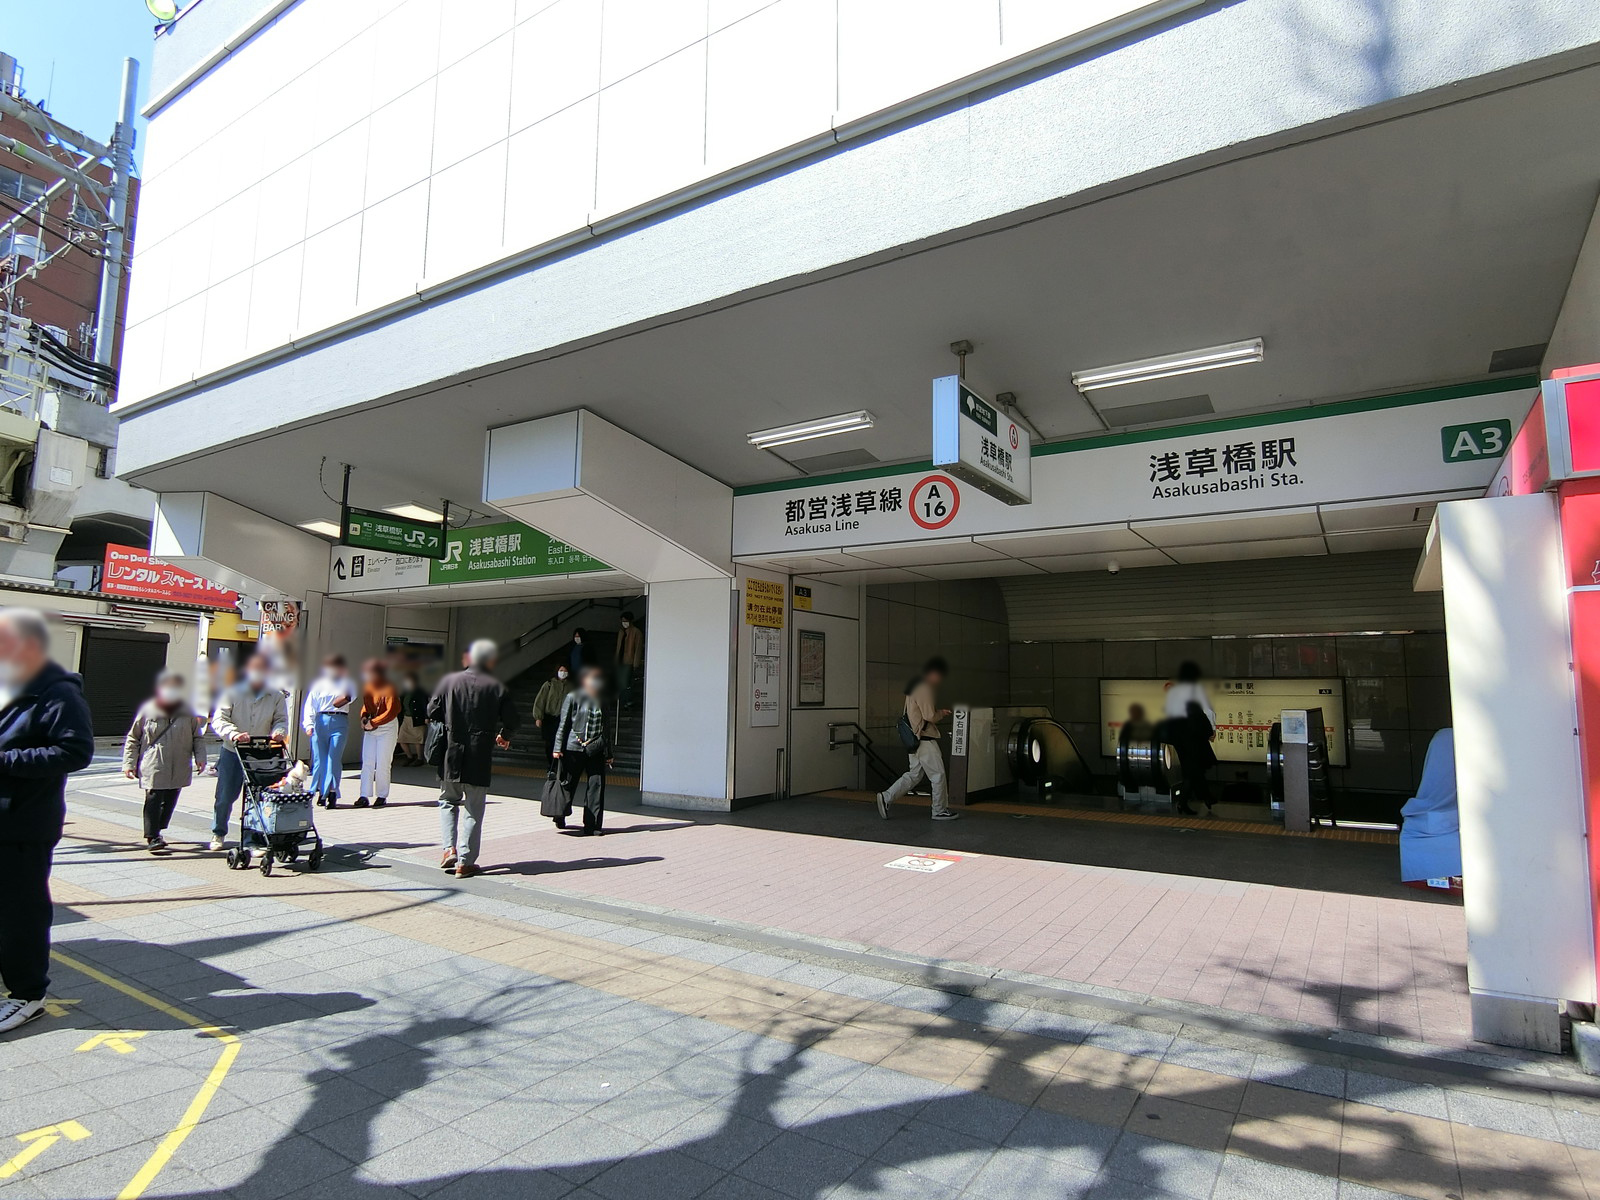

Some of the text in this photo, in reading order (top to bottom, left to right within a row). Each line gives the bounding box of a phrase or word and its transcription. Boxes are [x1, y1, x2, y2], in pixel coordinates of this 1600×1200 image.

[1450, 427, 1503, 458] A3
[981, 435, 1012, 472] 浅草橋駅
[1149, 437, 1297, 483] 浅草橋駅
[979, 456, 1007, 478] Asakusabashi
[927, 484, 941, 500] A
[1152, 472, 1304, 500] Asakusabashi Sta.
[785, 487, 903, 523] 都営浅草線
[924, 501, 947, 518] 16
[375, 524, 402, 535] 浅草橋駅
[785, 519, 860, 537] Asakusa Line
[404, 530, 426, 545] JR
[468, 533, 522, 557] 浅草橋駅
[548, 545, 563, 555] East
[110, 551, 169, 567] One Day Shop
[368, 557, 393, 566] エレベーター
[440, 563, 459, 571] JR東日本
[468, 554, 537, 571] Asakusabashi Station
[108, 562, 160, 584] レンタル
[161, 571, 204, 590] スペース
[265, 602, 289, 611] CAE
[263, 612, 294, 622] DINING
[263, 623, 284, 632] BAR
[955, 720, 964, 754] 右側通行
